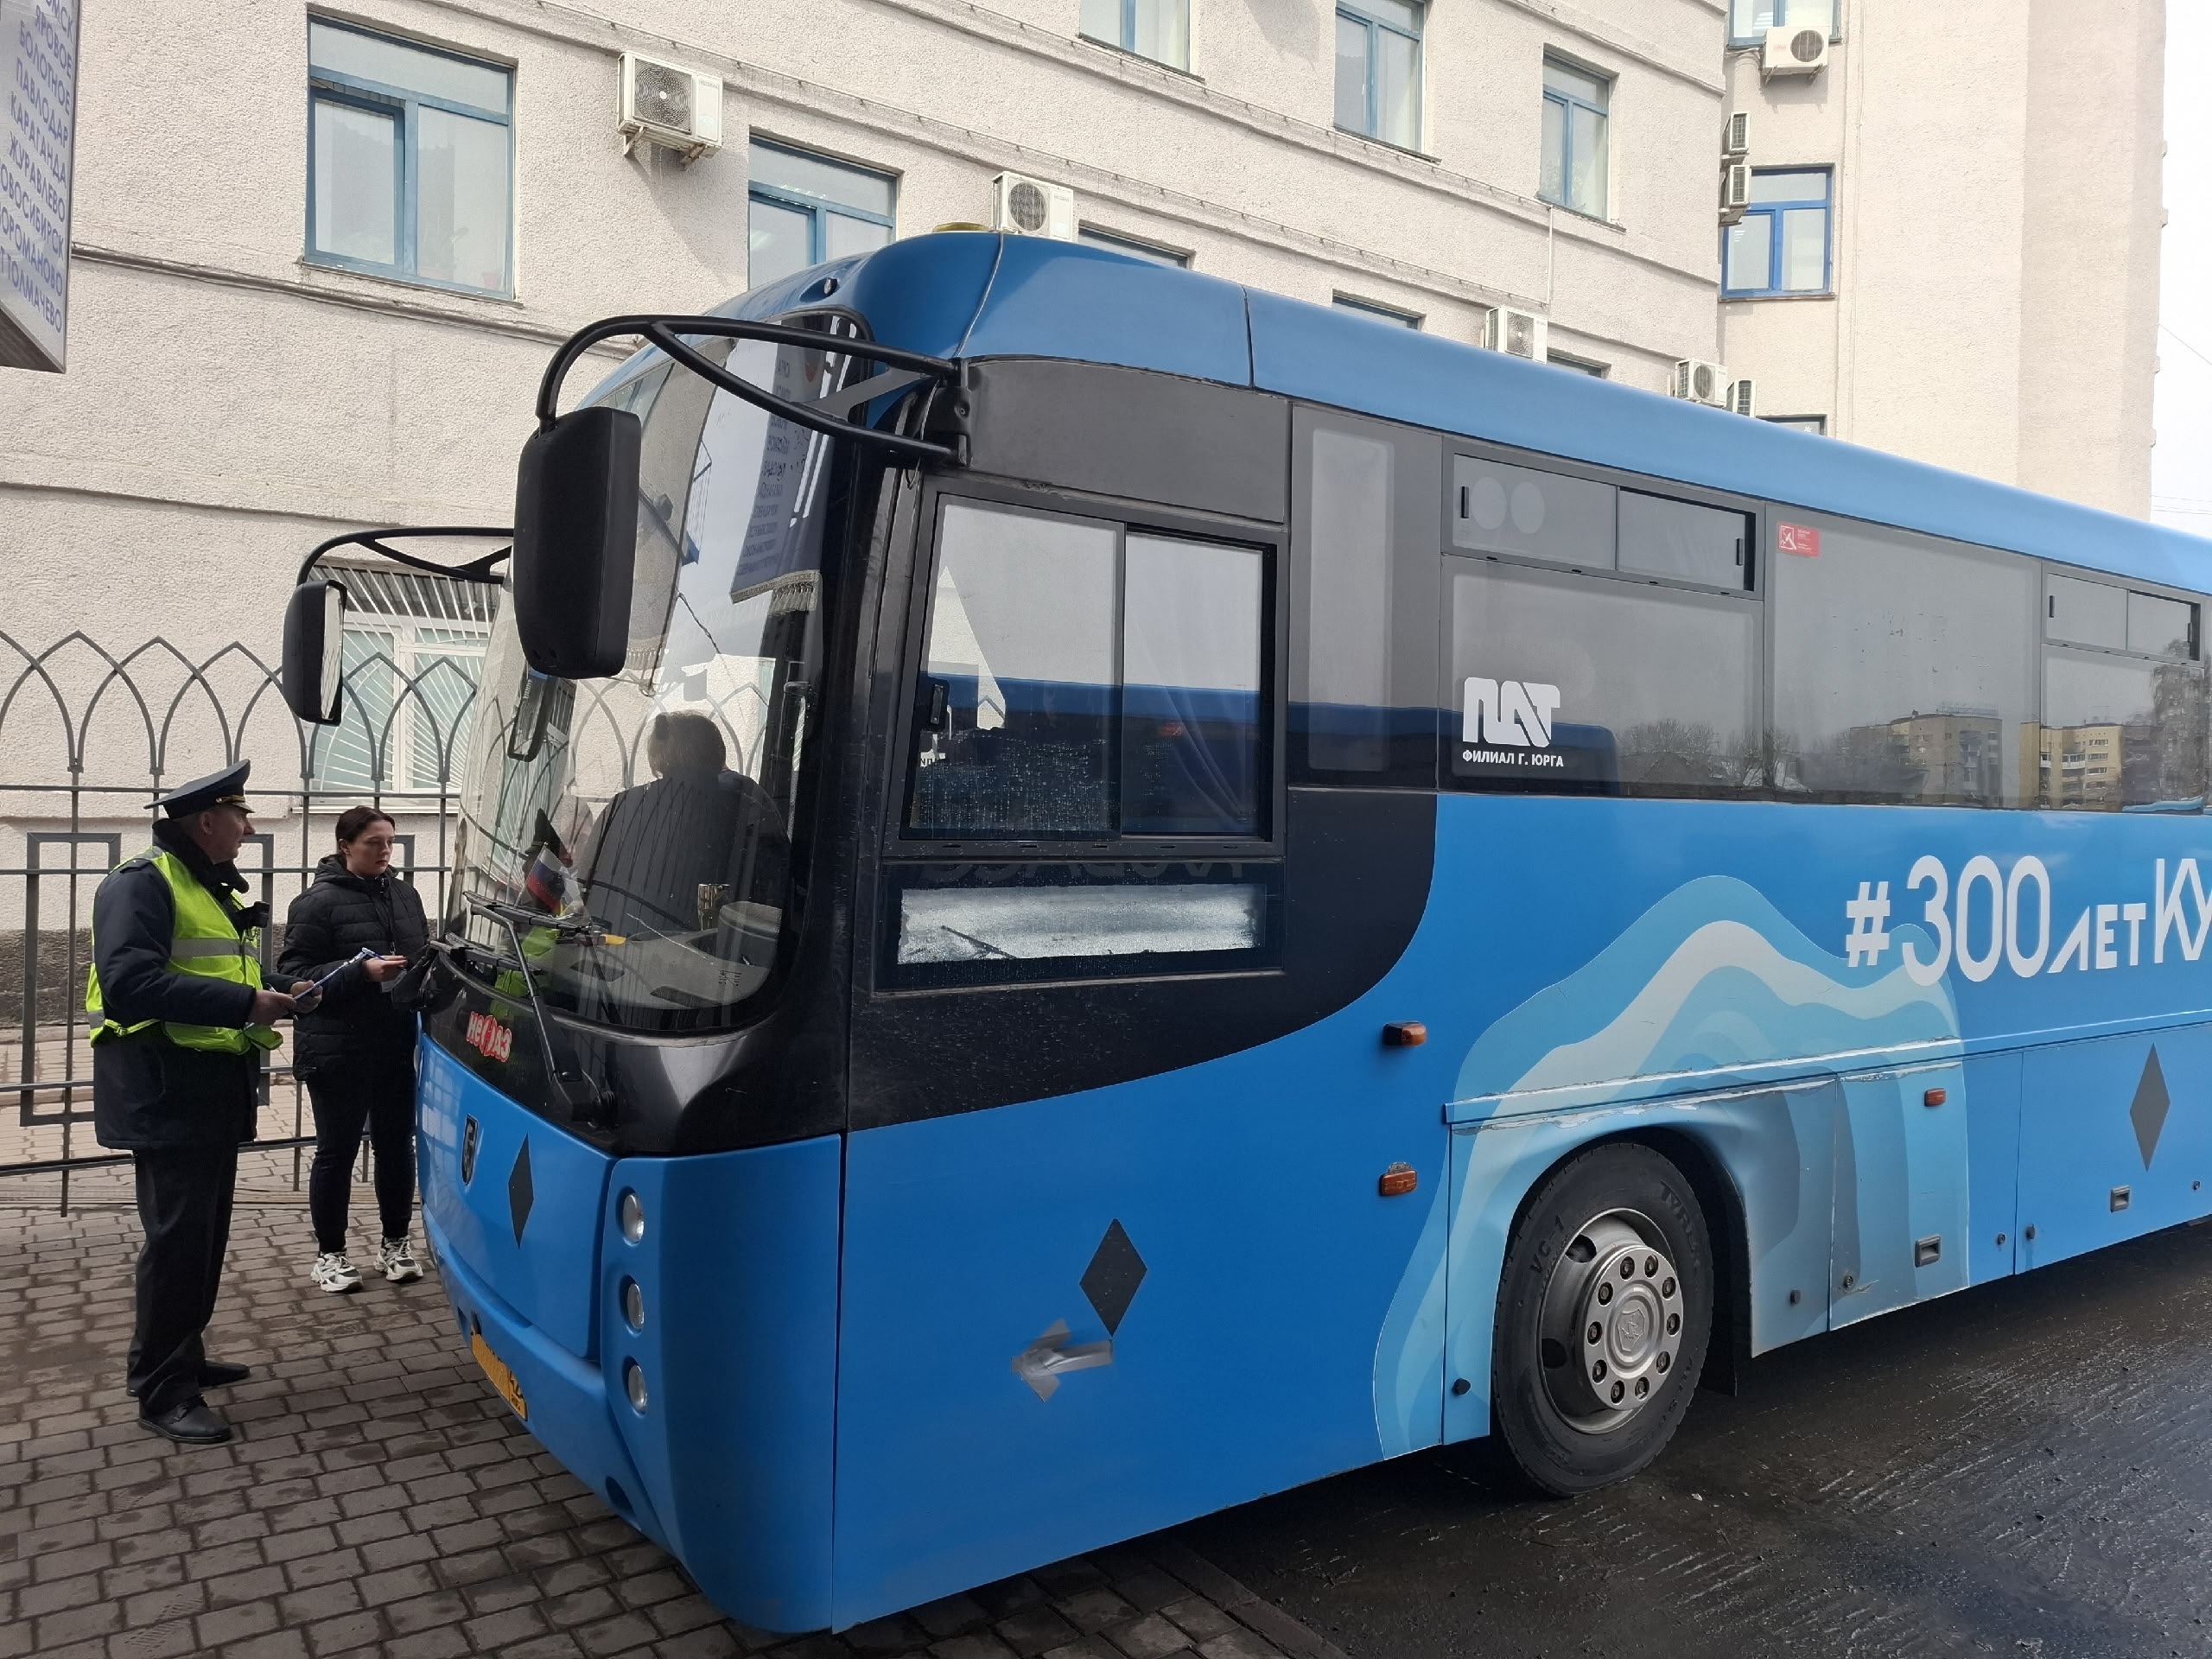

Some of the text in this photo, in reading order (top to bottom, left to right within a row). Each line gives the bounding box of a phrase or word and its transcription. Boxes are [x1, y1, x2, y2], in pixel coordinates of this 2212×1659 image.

[35, 4, 73, 79] ЯРОВОЕ
[46, 0, 73, 44] МСК
[16, 56, 68, 149] ПАВЛОДАР
[20, 20, 70, 116] БОЛОТНОЕ
[10, 90, 67, 188] КАРАГАНДА
[10, 130, 65, 223] ЖУРАВЛЕВО
[0, 162, 64, 261] ОВОСИБИРСК
[1, 207, 62, 296] ОРОМАНОВО
[7, 252, 61, 334] ТОЛМАЧЕВО
[1462, 749, 1565, 767] ФИЛИАЛ Г. ЮРГА
